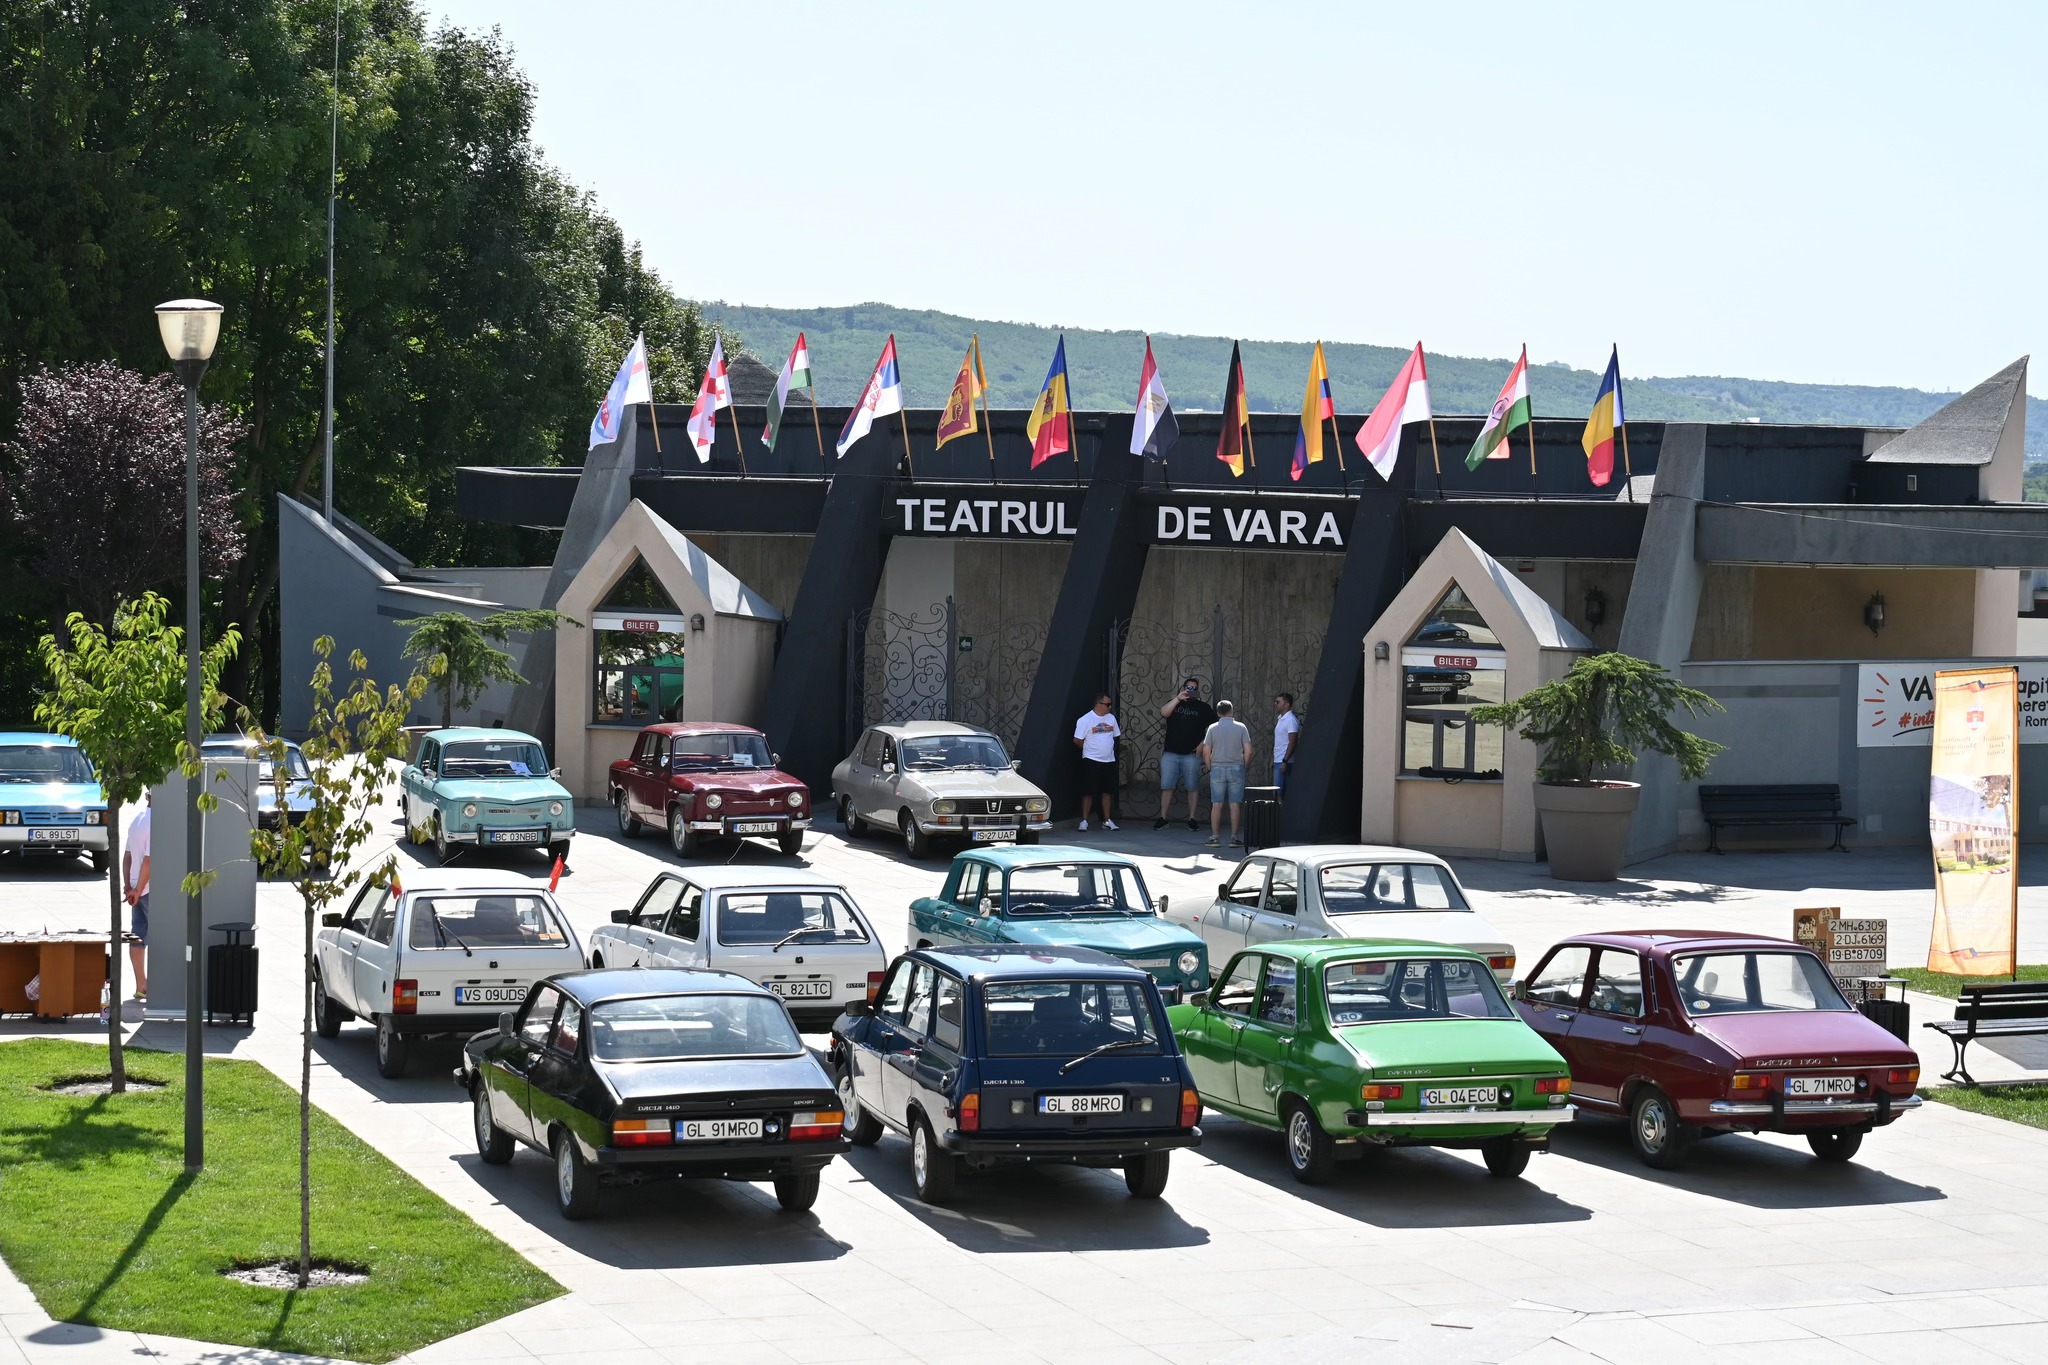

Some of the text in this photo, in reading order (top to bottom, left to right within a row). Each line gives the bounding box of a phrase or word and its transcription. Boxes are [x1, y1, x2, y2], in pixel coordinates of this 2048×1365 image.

[897, 498, 1343, 546] TEATRUL DE VARA
[626, 621, 655, 630] BILETE
[1438, 656, 1472, 667] BILETE
[1900, 675, 1934, 702] VA
[739, 824, 749, 832] GL
[35, 830, 46, 839] GL
[495, 832, 507, 841] BC
[976, 832, 985, 840] IS
[464, 989, 481, 1001] VS
[771, 984, 787, 995] GL
[1340, 1013, 1358, 1021] RO
[1793, 1080, 1809, 1093] GL
[1428, 1090, 1445, 1104] GL
[1047, 1098, 1065, 1112] GL
[686, 1123, 706, 1138] GL
